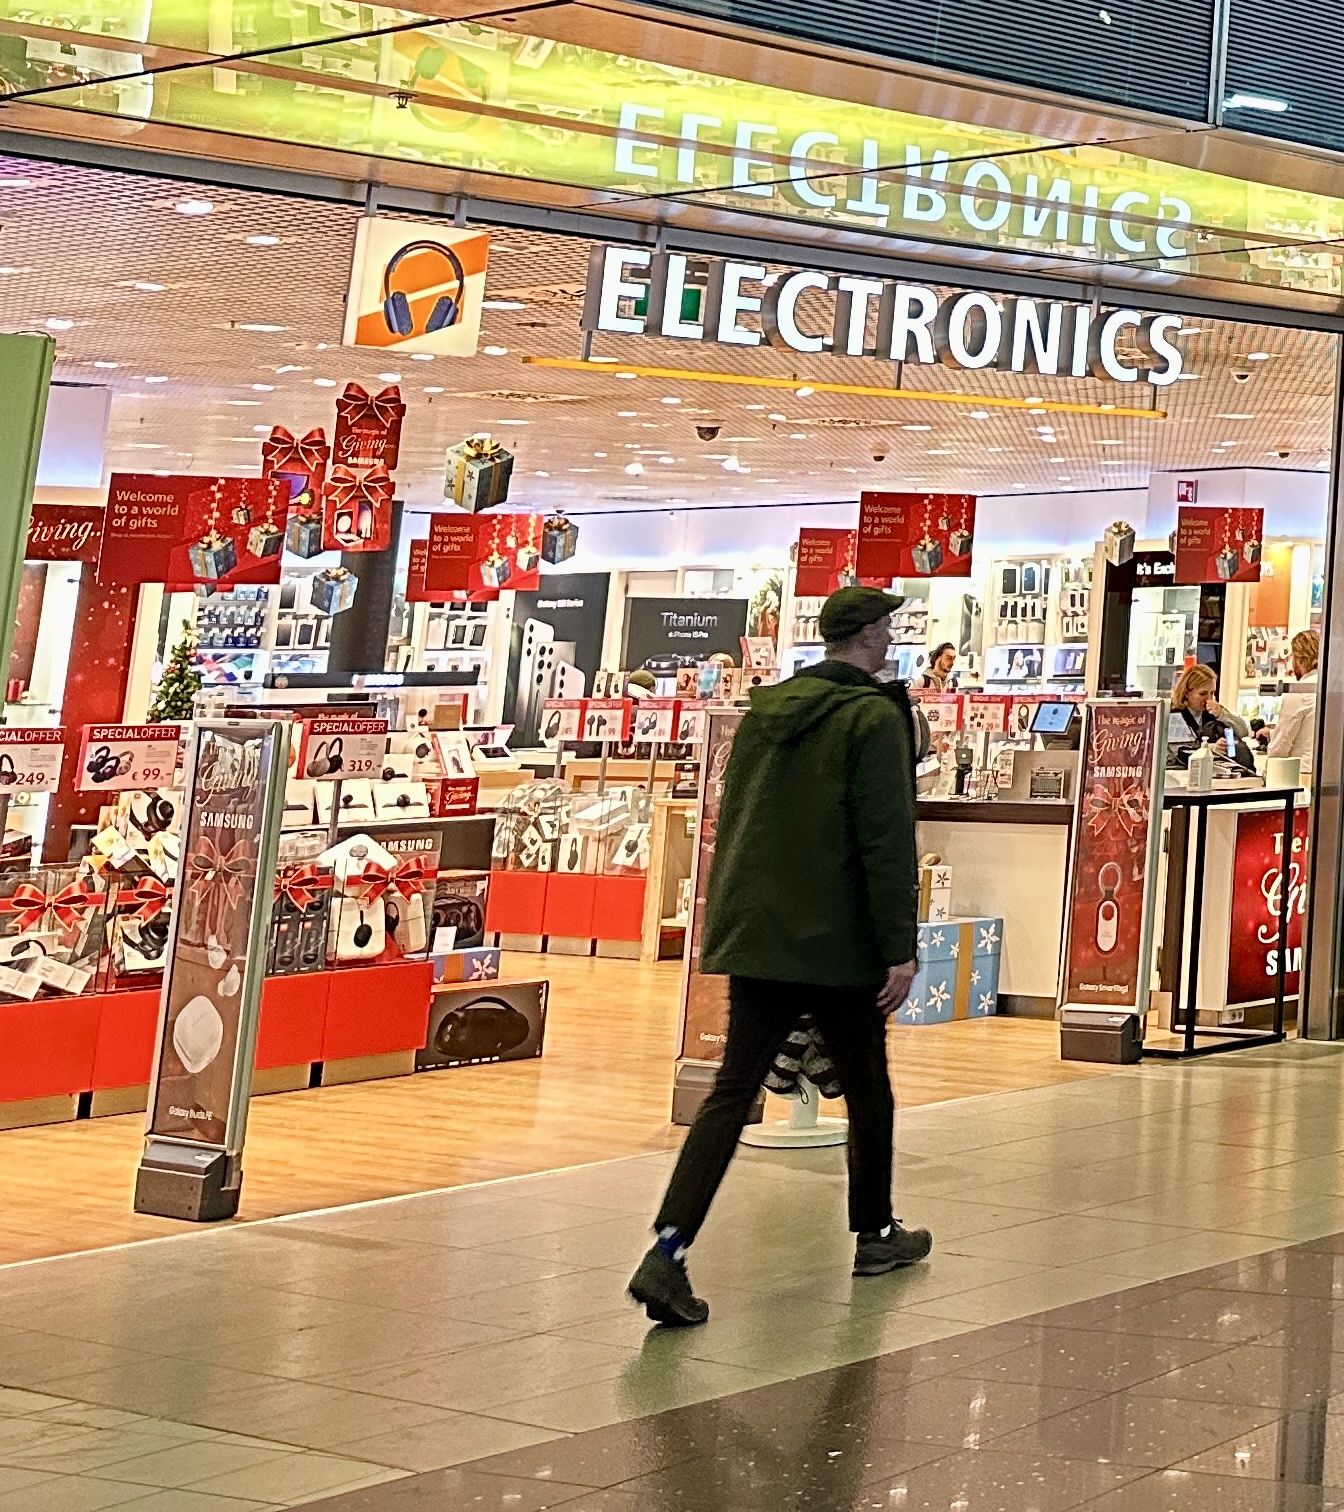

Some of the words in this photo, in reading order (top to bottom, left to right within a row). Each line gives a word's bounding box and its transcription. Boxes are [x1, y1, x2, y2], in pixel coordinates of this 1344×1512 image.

[600, 246, 1185, 387] ELECTRONICS
[116, 490, 174, 503] Welcome
[114, 504, 128, 515] to
[131, 506, 139, 515] a
[141, 504, 179, 516] world
[864, 504, 901, 514] Welcome
[112, 517, 125, 527] of
[129, 517, 158, 531] gifts
[864, 516, 872, 524] to
[881, 515, 904, 524] world
[863, 525, 872, 533] of
[873, 525, 892, 535] gifts
[660, 612, 718, 627] Titanium
[0, 730, 62, 743] CIALOFFER
[1093, 766, 1143, 778] SAMSUNG
[200, 811, 254, 829] SAMSUNG
[379, 838, 433, 851] AMSUNG
[1273, 832, 1302, 855] Te
